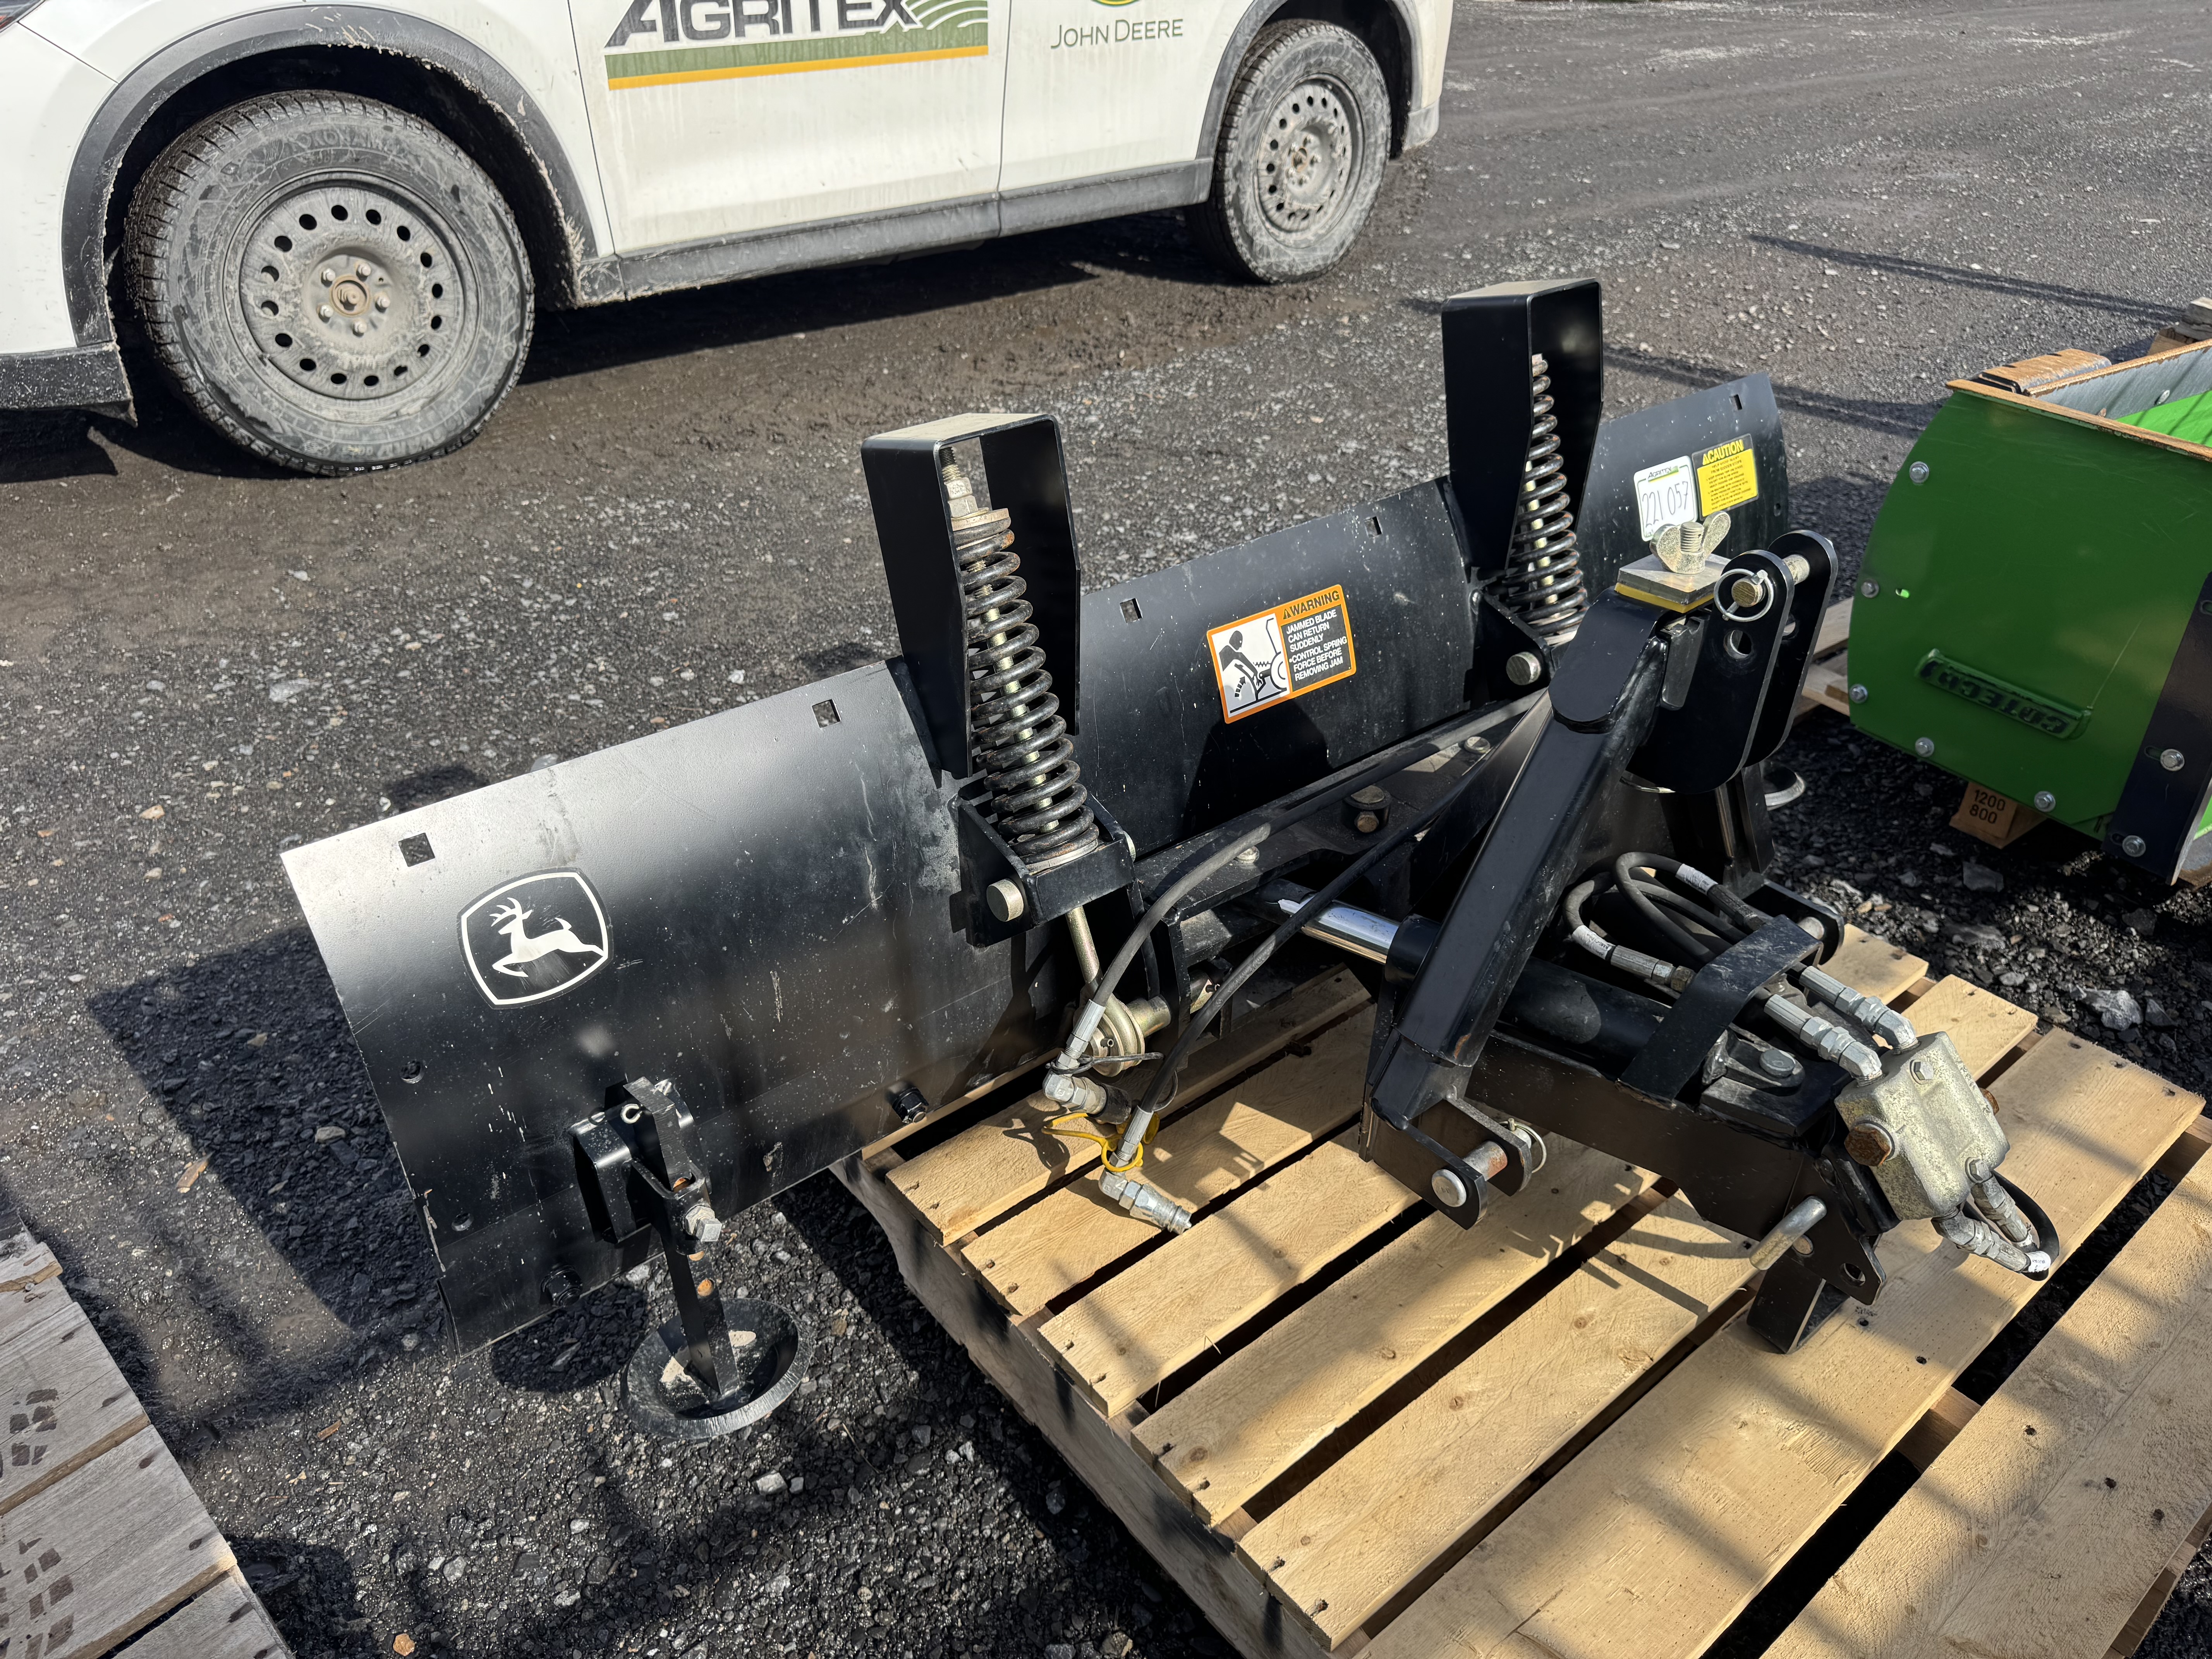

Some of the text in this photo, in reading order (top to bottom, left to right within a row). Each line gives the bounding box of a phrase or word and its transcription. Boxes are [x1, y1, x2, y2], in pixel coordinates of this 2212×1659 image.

[1051, 19, 1183, 49] JOHN DEERE
[1707, 439, 1744, 462] CAUTION
[1290, 591, 1340, 616] WARNING
[1286, 609, 1337, 634] JAMMED BLADE
[1288, 622, 1330, 643] CAN RETURN
[1290, 633, 1324, 653] SUDDENLY
[1323, 636, 1347, 651] SPRING
[1293, 647, 1342, 672] FORCE BEFORE
[1295, 656, 1343, 682] REMOVING JAM
[1975, 790, 2006, 811] 1200
[1969, 804, 1997, 824] 800
